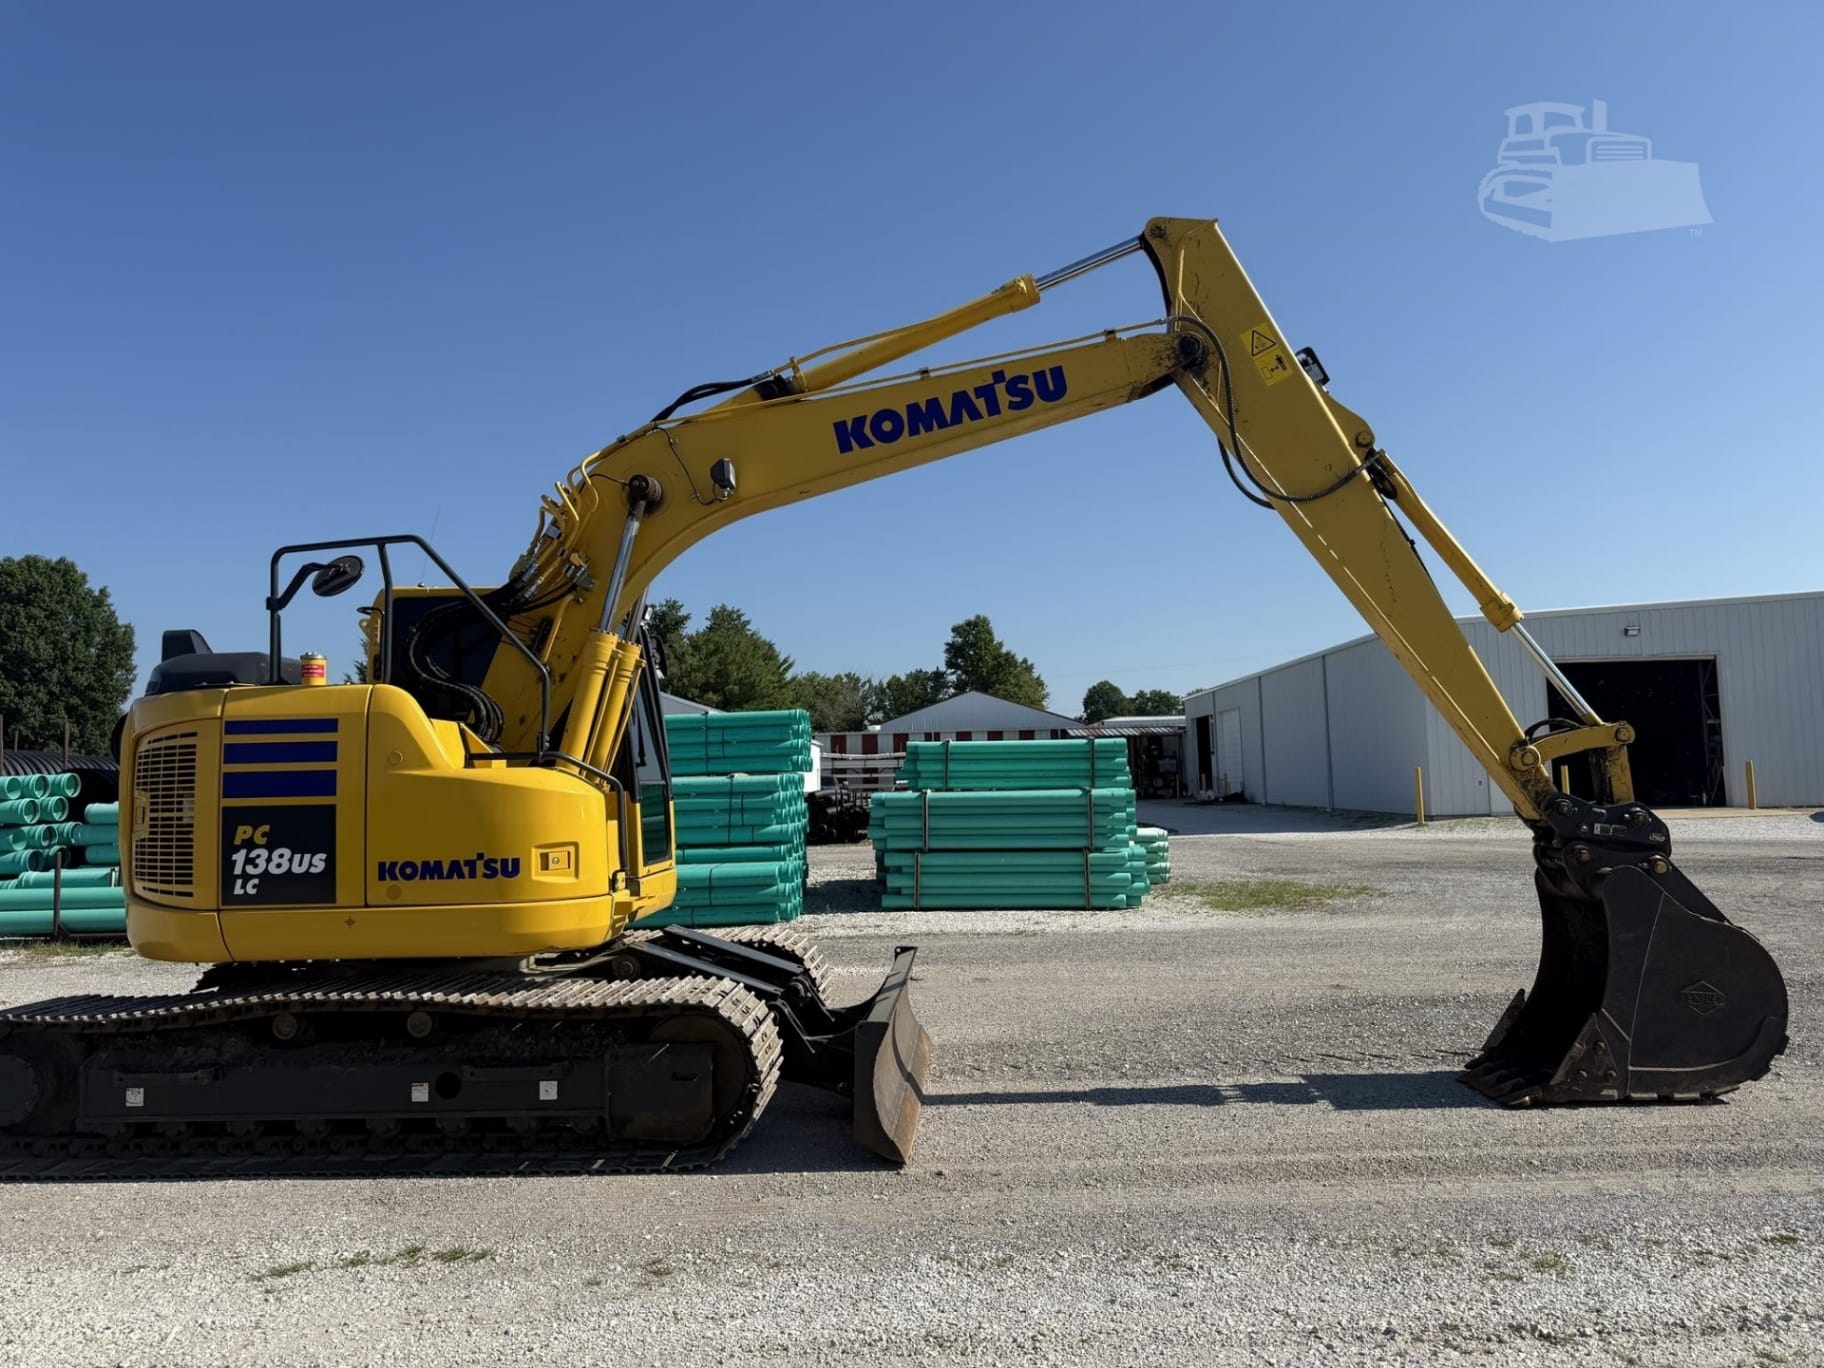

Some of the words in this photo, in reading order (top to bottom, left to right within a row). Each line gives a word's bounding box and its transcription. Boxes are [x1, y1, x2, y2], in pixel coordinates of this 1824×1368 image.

[833, 365, 1067, 454] KOMATSU
[233, 824, 271, 845] PC
[377, 852, 520, 881] KOMATSU
[233, 878, 260, 895] LC
